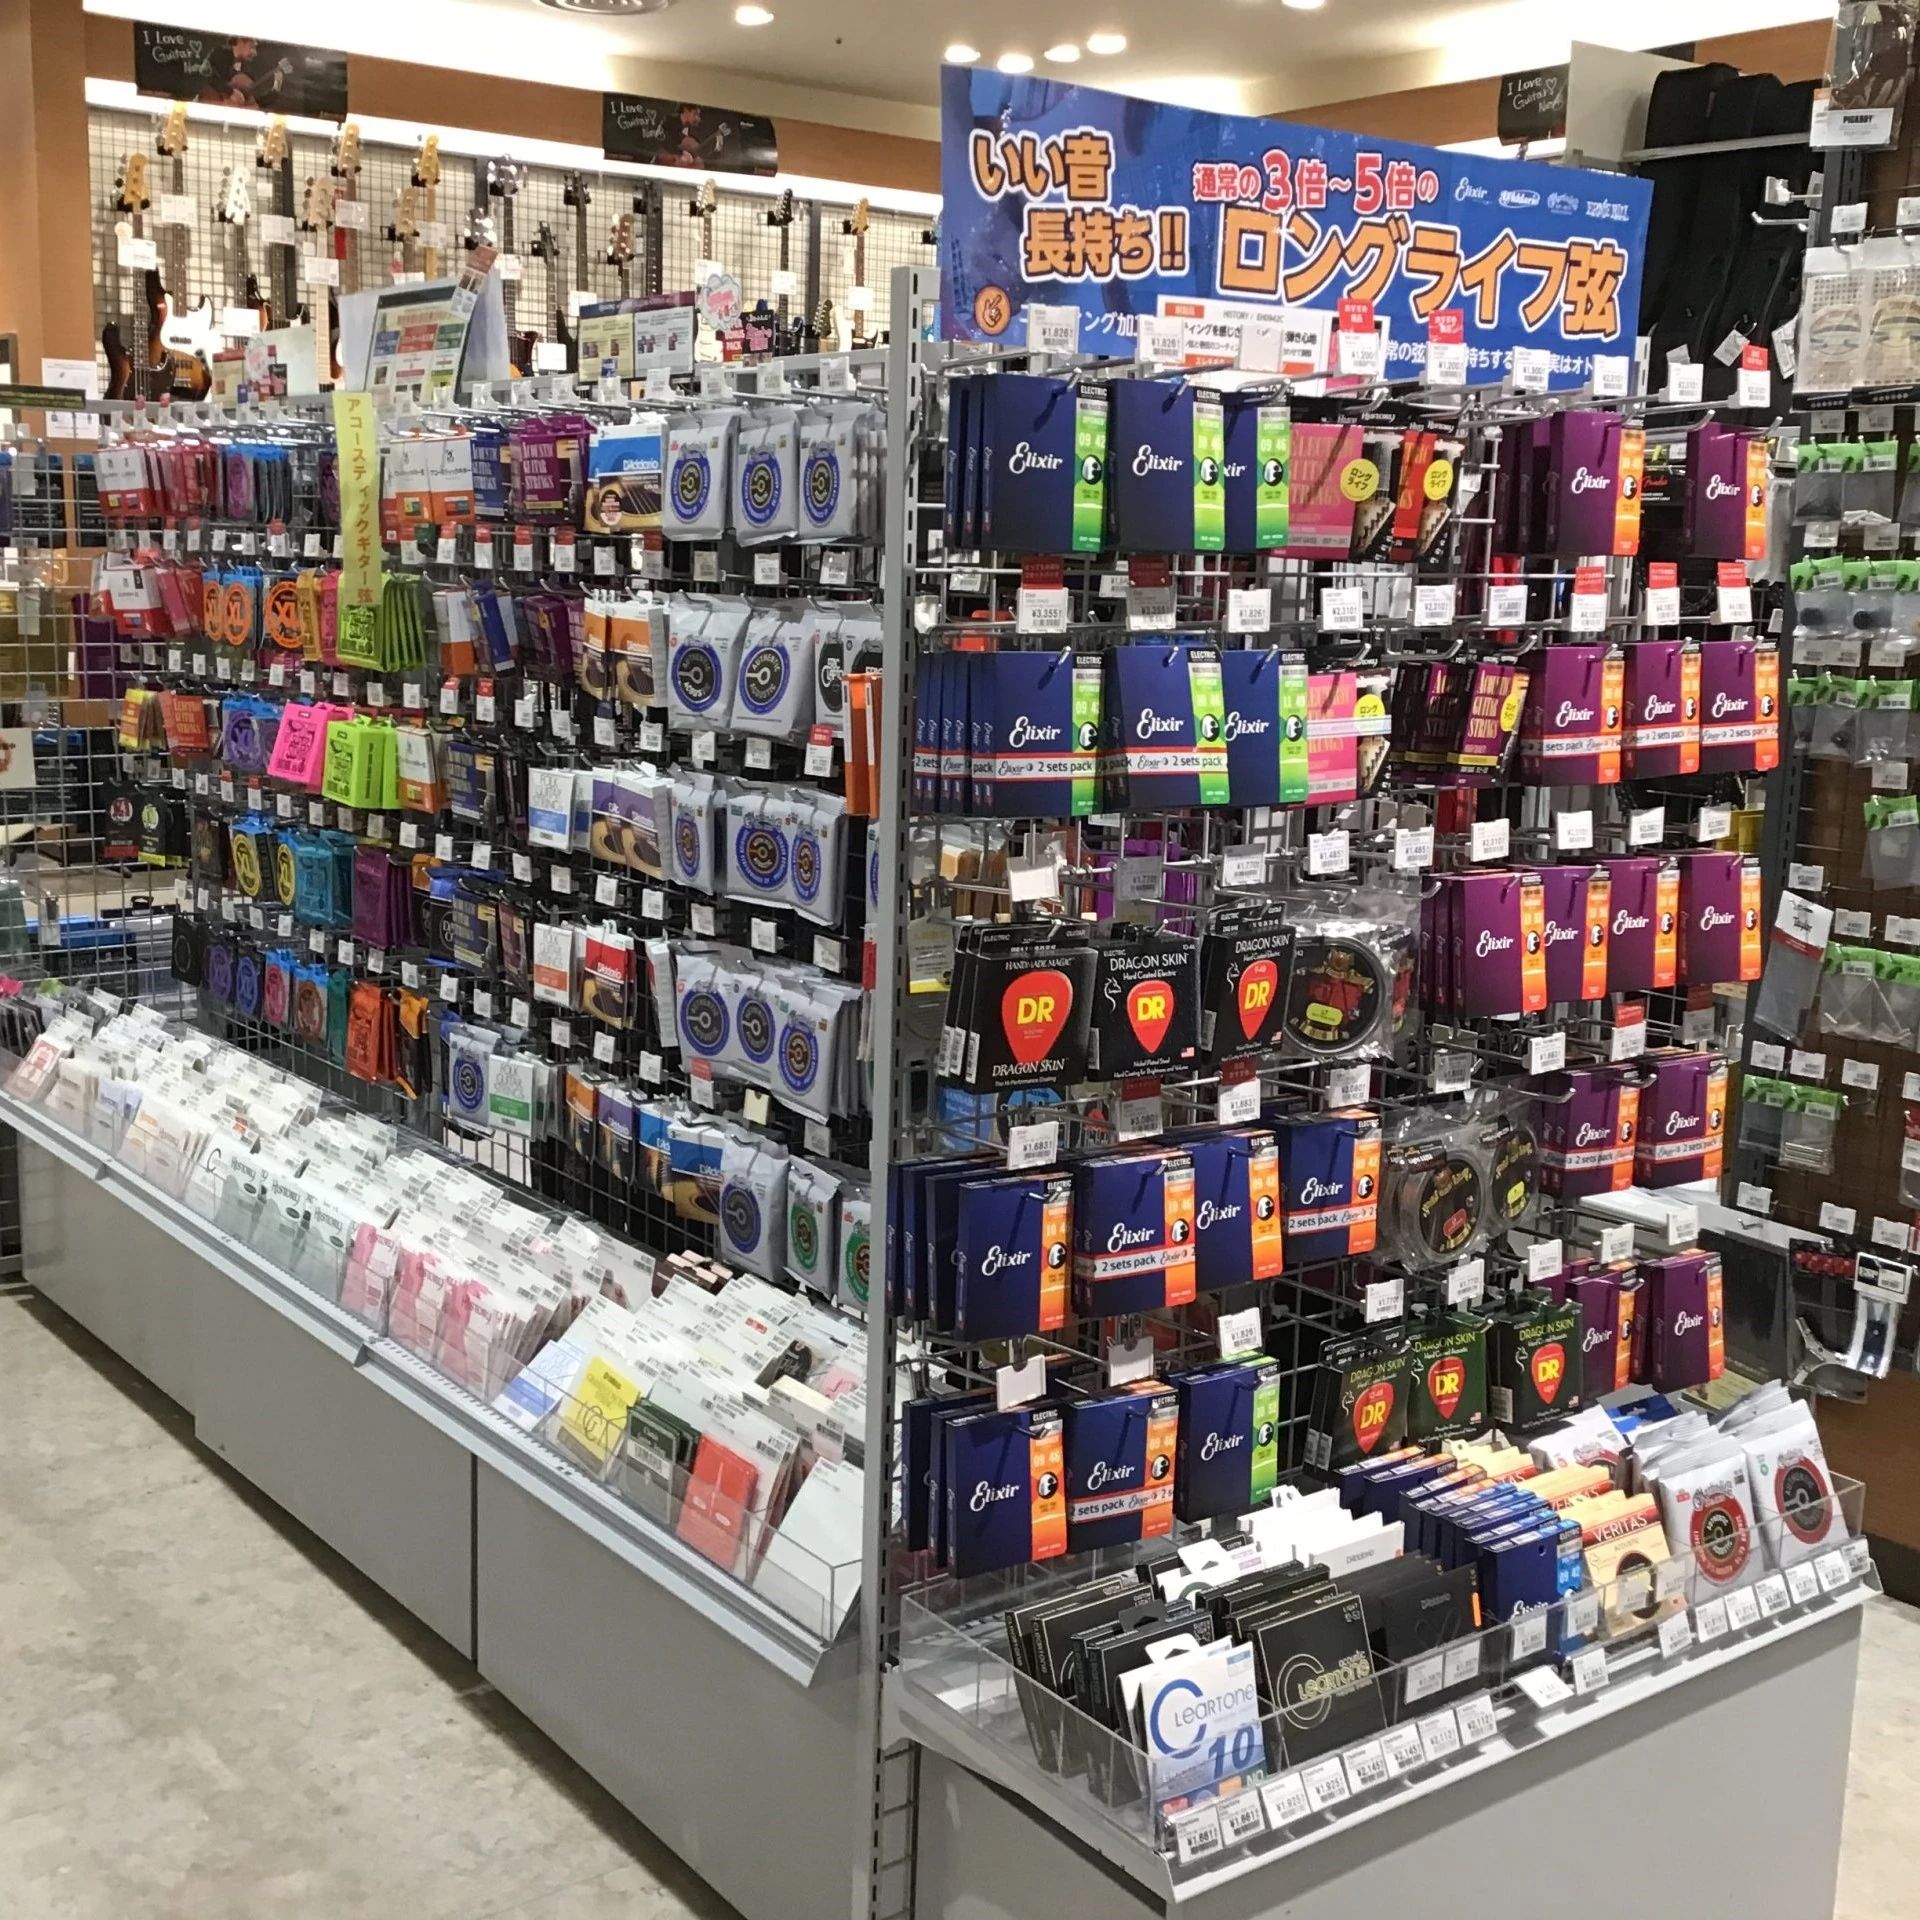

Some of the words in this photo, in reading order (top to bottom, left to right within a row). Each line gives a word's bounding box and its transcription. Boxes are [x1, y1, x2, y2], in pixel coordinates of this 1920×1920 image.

[156, 30, 184, 45] Love
[1518, 77, 1541, 92] Love
[620, 101, 643, 114] Love
[972, 131, 1114, 201] いい音
[1454, 176, 1488, 201] Elixir
[1219, 206, 1628, 341] ロングライフ弦
[1080, 386, 1107, 398] ELECTRIC
[1196, 389, 1221, 401] ELECTRIC
[1009, 441, 1063, 475] Elixir
[1132, 444, 1183, 477] Elixir
[1347, 476, 1369, 491] ライフ
[1350, 466, 1373, 481] ロング
[1430, 478, 1447, 488] ライフ
[1431, 470, 1448, 479] ロング
[1570, 466, 1611, 495] Elixir
[1706, 474, 1741, 500] Elixir
[346, 397, 374, 605] アコースティックギター弦
[752, 652, 781, 672] AUTHENTIC
[1190, 650, 1216, 660] ELECTRIC
[1281, 652, 1305, 662] ELECTRIC
[1555, 700, 1595, 727] Elixir
[1644, 694, 1676, 721] Elixir
[1711, 692, 1749, 718] Elixir
[1009, 715, 1062, 748] Elixir
[1136, 708, 1184, 739] Elixir
[1225, 710, 1269, 741] Elixir
[1656, 729, 1670, 740] sets
[1728, 727, 1735, 738] 2
[1735, 726, 1751, 738] sets
[1545, 741, 1564, 752] sets
[973, 759, 994, 774] pack
[1037, 760, 1045, 773] 2
[1048, 760, 1068, 773] sets
[1069, 760, 1093, 776] pack
[1172, 753, 1180, 766] 2
[1181, 753, 1200, 766] sets
[1202, 753, 1223, 768] pack
[1612, 909, 1650, 935] Elixir
[1700, 906, 1735, 931] Elixir
[1235, 938, 1271, 954] DRAGON
[1271, 934, 1290, 948] SKIN
[1475, 929, 1514, 957] Elixir
[1542, 920, 1578, 948] Elixir
[1110, 953, 1160, 971] DRAGON
[1161, 952, 1187, 967] SKIN
[1244, 980, 1271, 1010] DR
[1017, 995, 1055, 1025] DR
[1137, 996, 1166, 1021] DR
[992, 1060, 1039, 1078] DRAGON
[1040, 1057, 1066, 1072] SKIN
[1575, 1122, 1611, 1148] Elixir
[1665, 1110, 1700, 1136] Elixir
[1167, 1157, 1191, 1168] ELECTRIC
[1301, 1177, 1344, 1205] Elixir
[1196, 1200, 1241, 1230] Elixir
[1289, 1218, 1295, 1229] 2
[1296, 1217, 1317, 1228] sets
[1317, 1213, 1338, 1228] pack
[1107, 1222, 1155, 1253] Elixir
[981, 1245, 1032, 1277] Elixir
[1101, 1260, 1109, 1272] 2
[1109, 1258, 1131, 1272] sets
[1133, 1255, 1157, 1270] pack
[1554, 1318, 1575, 1332] SKIN
[1674, 1310, 1704, 1337] Elixir
[1454, 1330, 1476, 1345] SKIN
[1582, 1326, 1613, 1353] Elixir
[1383, 1357, 1407, 1374] SKIN
[1537, 1357, 1561, 1382] DR
[1435, 1372, 1459, 1396] DR
[1032, 1409, 1058, 1420] ELECTRIC
[1359, 1399, 1386, 1429] DR
[1200, 1431, 1244, 1462] Elixir
[1087, 1461, 1135, 1491] Elixir
[969, 1480, 1020, 1512] Elixir
[1077, 1501, 1100, 1517] sets
[1101, 1498, 1125, 1514] pack
[1594, 1513, 1648, 1544] VERITAS
[1207, 1725, 1256, 1779] 10
